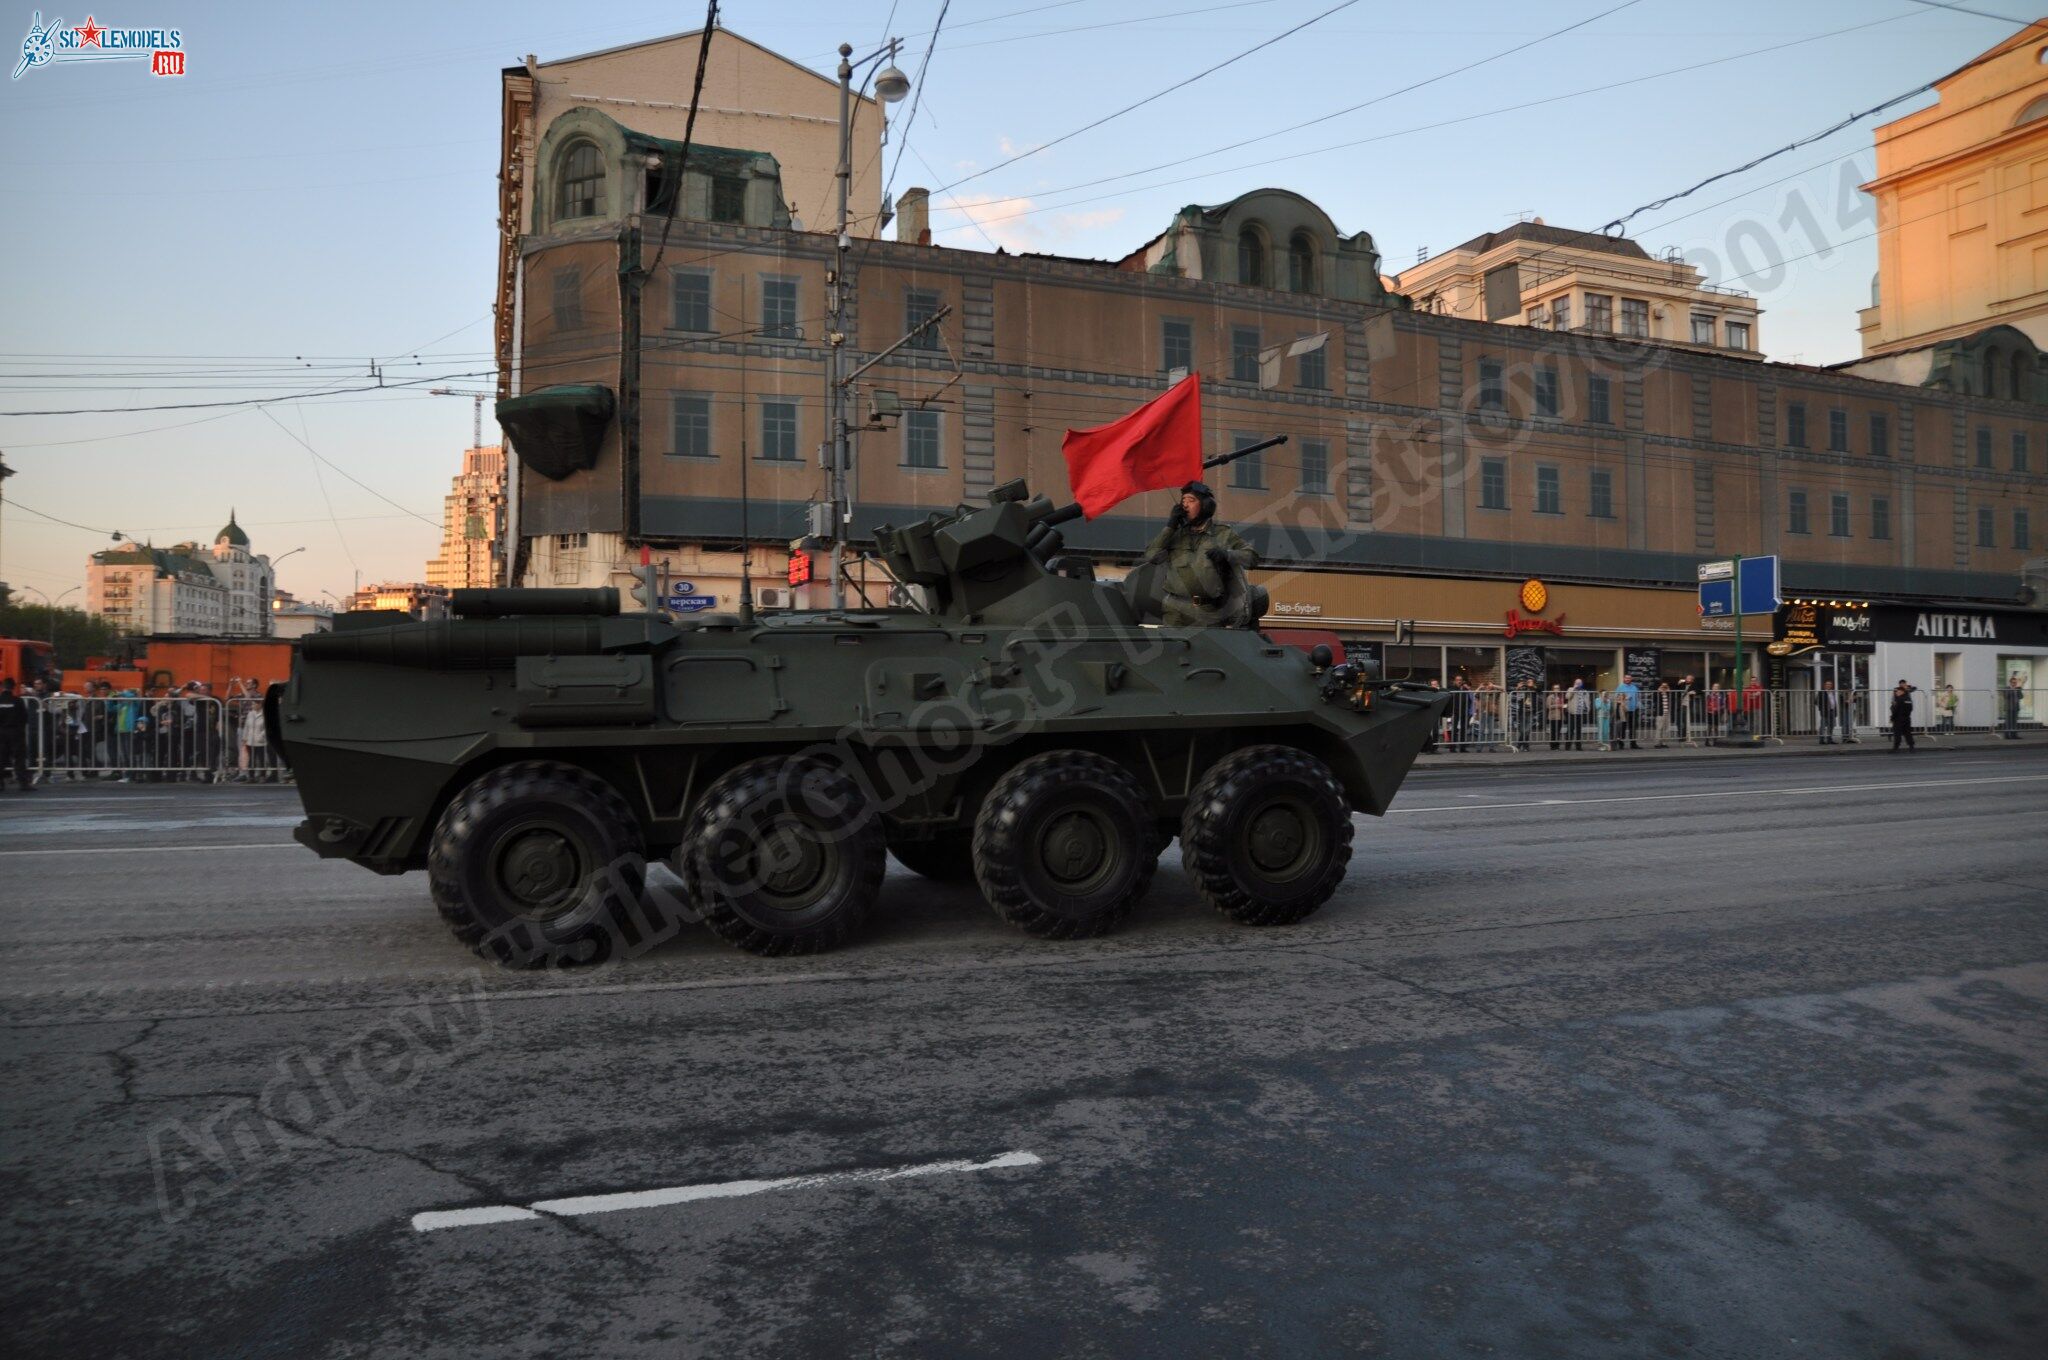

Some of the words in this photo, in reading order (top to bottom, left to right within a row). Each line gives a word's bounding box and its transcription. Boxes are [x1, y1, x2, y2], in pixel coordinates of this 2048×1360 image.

[678, 583, 691, 592] 30
[668, 599, 707, 607] верская
[1274, 602, 1321, 615] Бар-буфет
[1701, 619, 1735, 630] Бар-буфе
[1914, 613, 1997, 639] АПТЕКА
